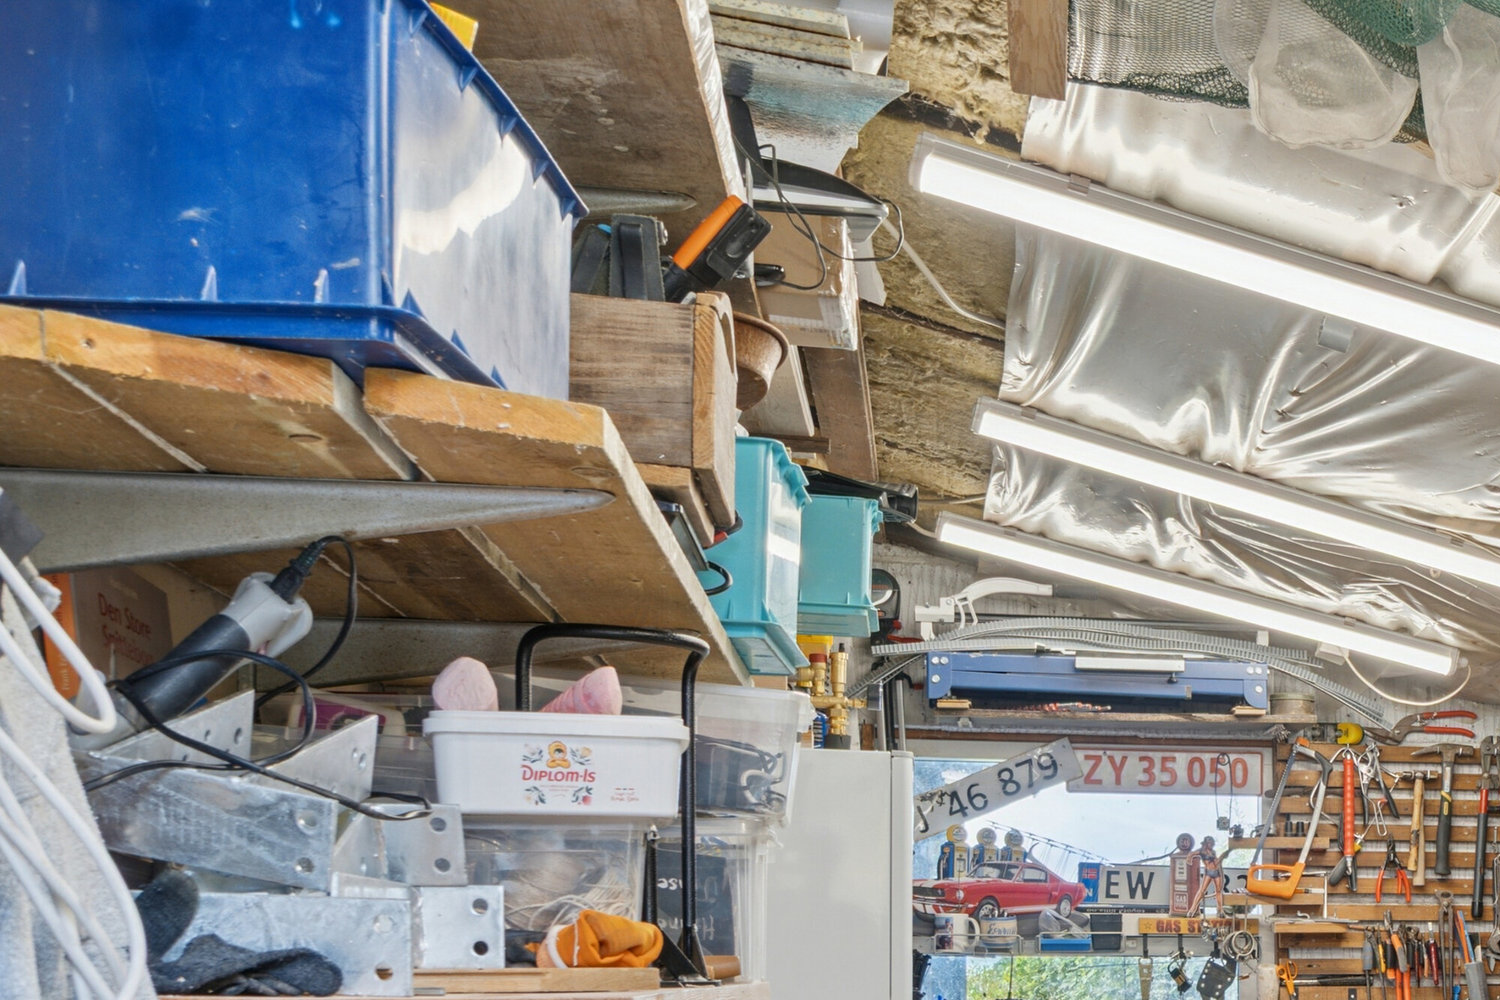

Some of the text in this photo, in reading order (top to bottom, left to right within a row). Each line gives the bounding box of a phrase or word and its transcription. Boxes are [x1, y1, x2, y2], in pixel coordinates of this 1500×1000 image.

[949, 782, 988, 818] 46
[997, 752, 1058, 796] 879
[1083, 754, 1248, 788] ZY 35 050
[1105, 870, 1155, 900] EW
[1156, 919, 1181, 933] GAS
